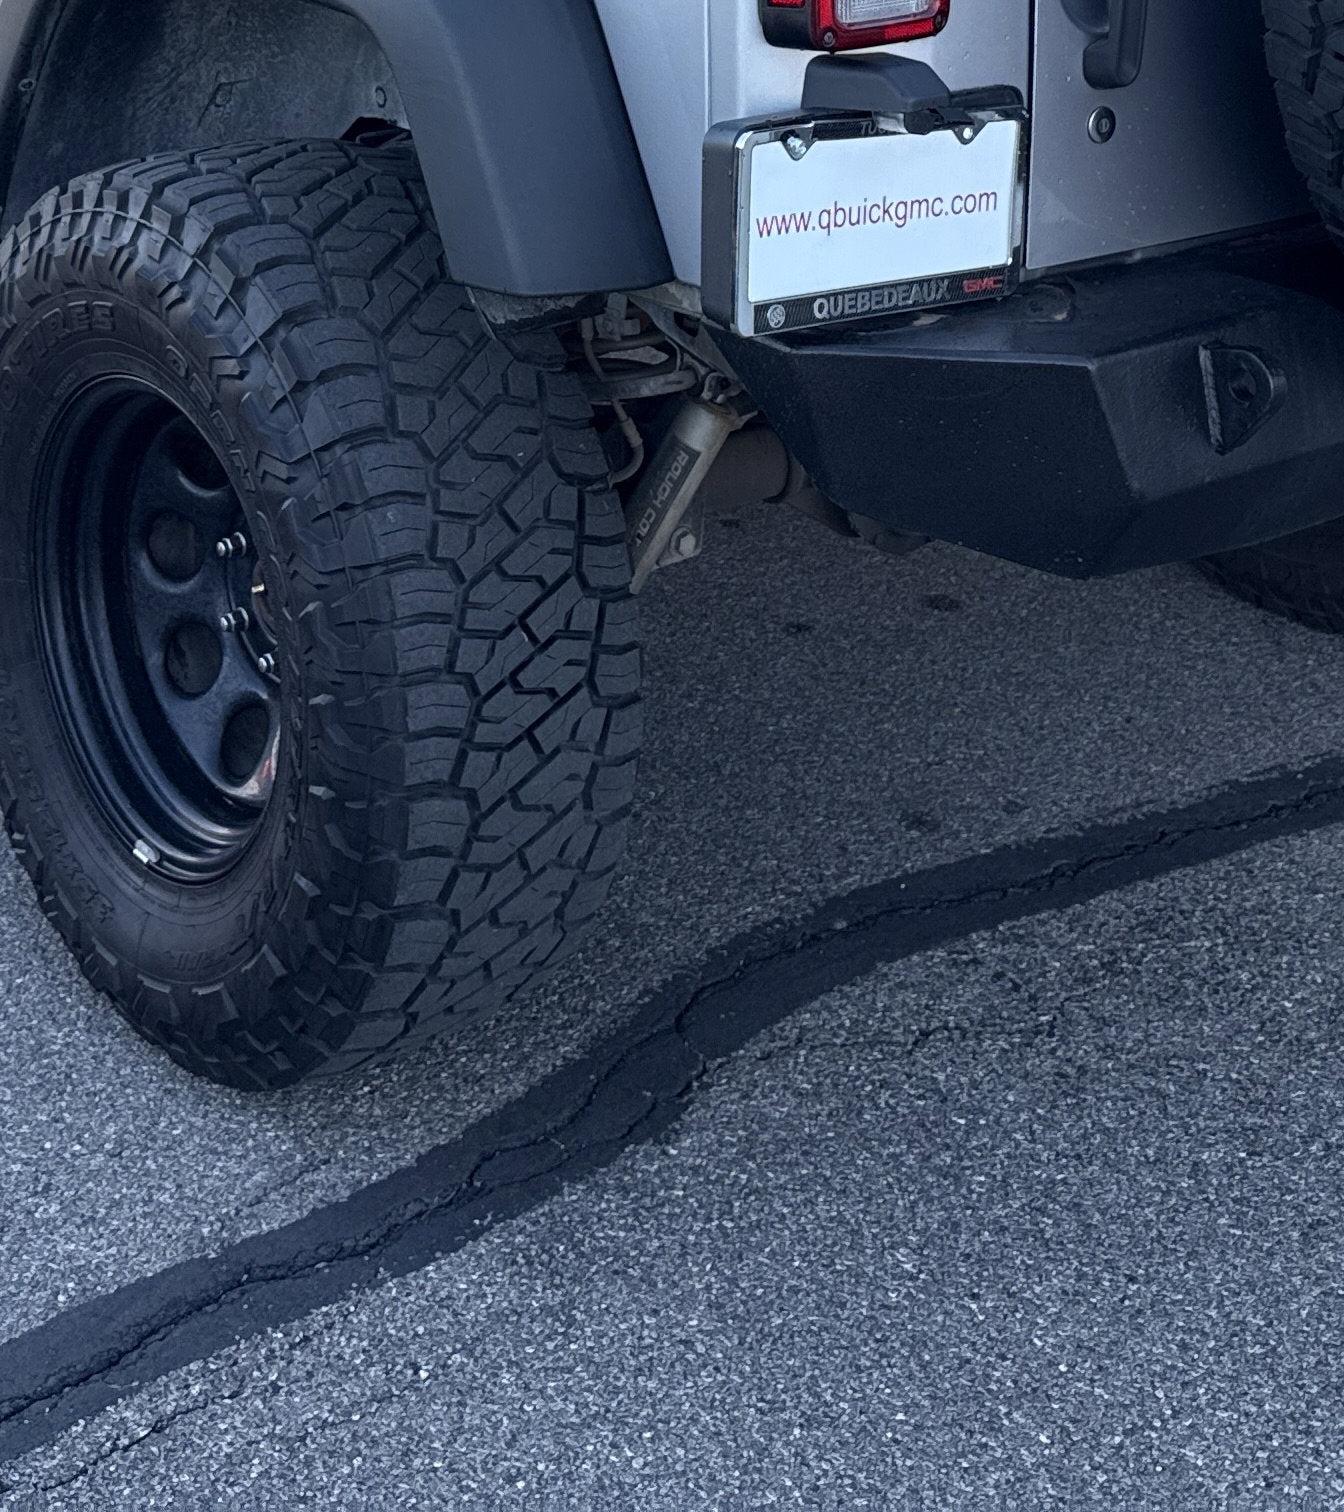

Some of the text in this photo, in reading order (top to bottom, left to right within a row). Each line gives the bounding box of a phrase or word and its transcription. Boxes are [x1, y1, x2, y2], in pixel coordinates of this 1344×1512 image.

[756, 190, 998, 239] www.qbuickgmc.com
[813, 275, 1003, 320] QUEBEDEAUX GMC
[9, 299, 117, 373] TIRES
[652, 450, 689, 508] ROUGH
